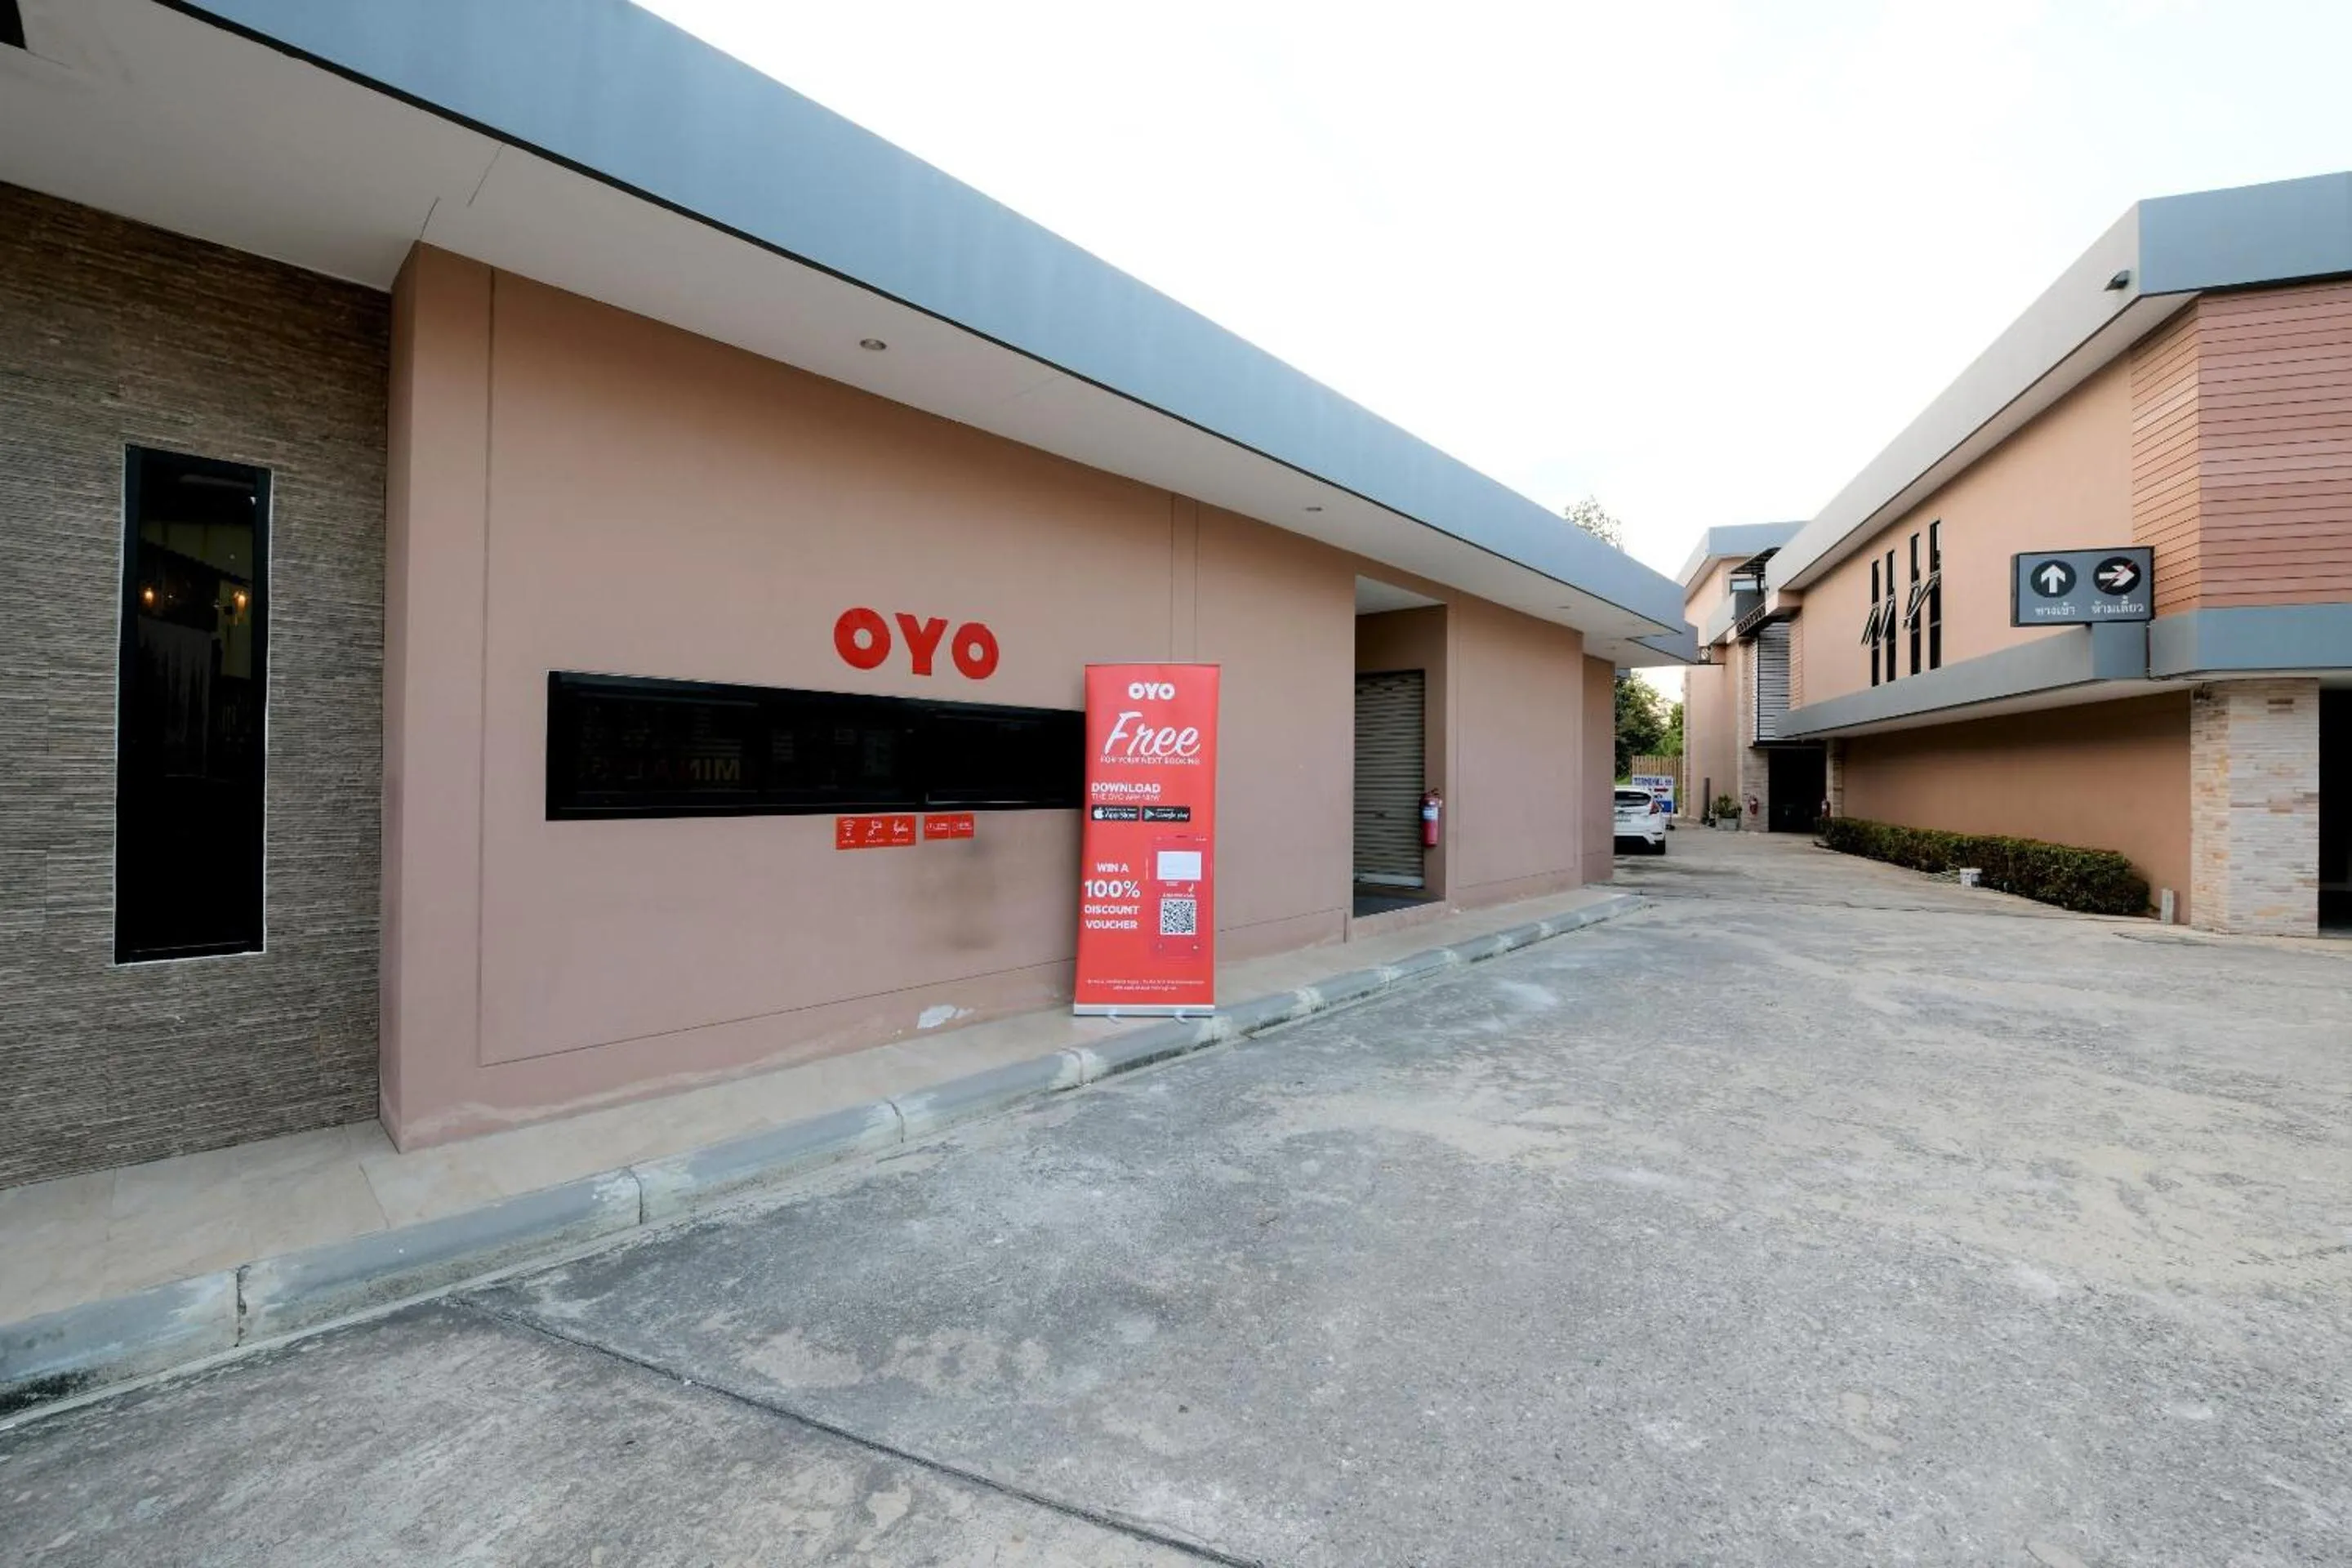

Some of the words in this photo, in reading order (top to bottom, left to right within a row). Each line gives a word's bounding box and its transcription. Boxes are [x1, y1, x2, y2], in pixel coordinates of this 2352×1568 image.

[2034, 602, 2075, 616] ทางเข้า
[834, 608, 999, 679] OYO
[1129, 683, 1175, 700] OYO
[1104, 711, 1200, 756] Free
[1141, 756, 1162, 764] NEXT
[1091, 782, 1160, 793] DOWNLOAD
[1097, 862, 1119, 872] WIN
[1120, 863, 1129, 872] A
[1085, 880, 1141, 898] 100%
[1085, 905, 1139, 915] DISCOUNT
[1085, 920, 1138, 929] VOUCHER
